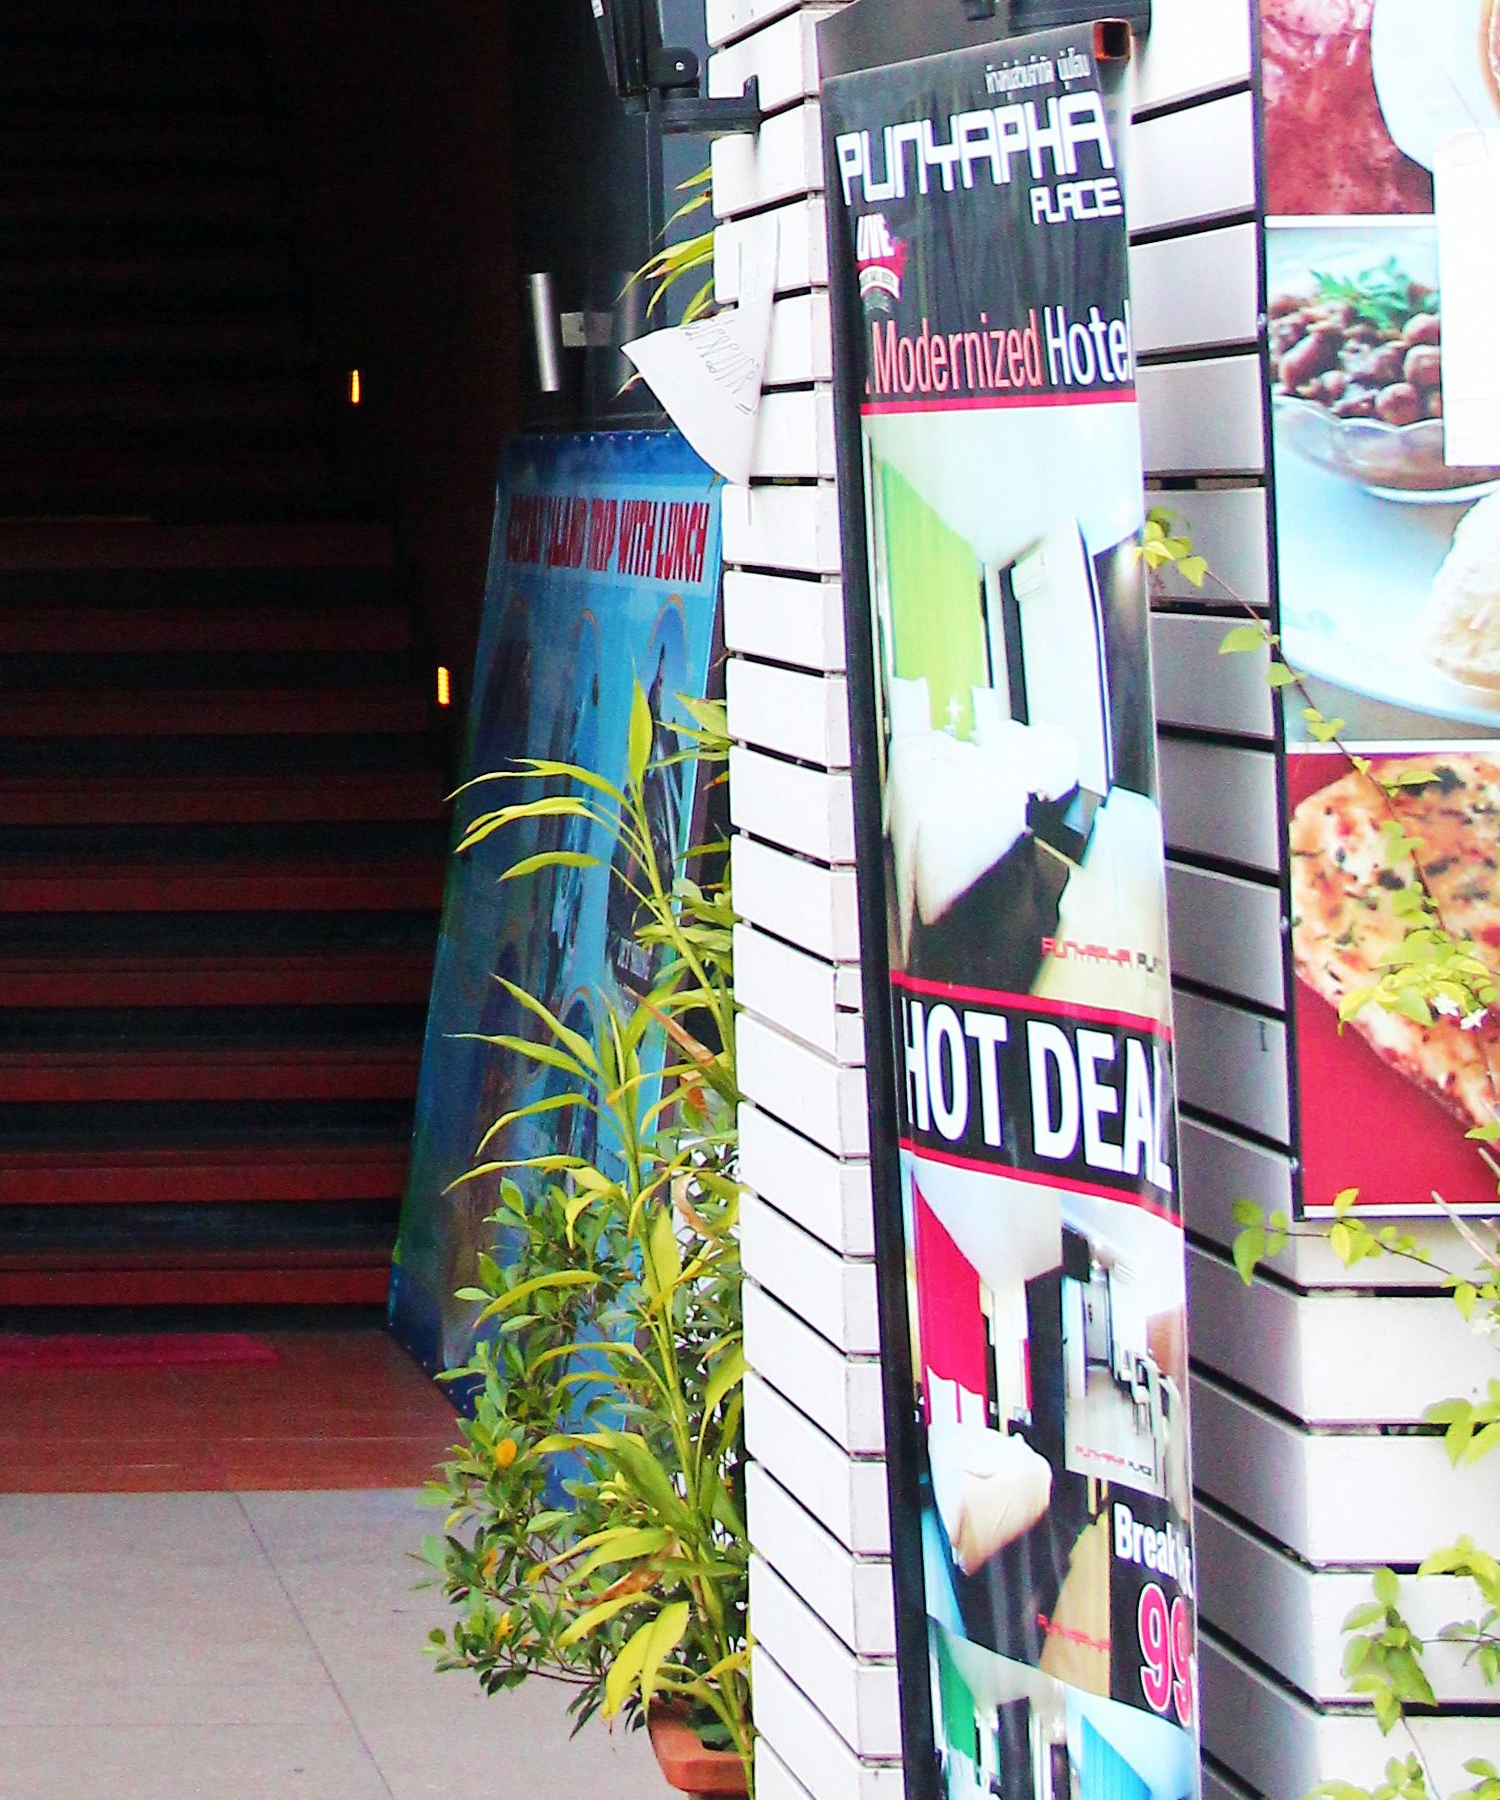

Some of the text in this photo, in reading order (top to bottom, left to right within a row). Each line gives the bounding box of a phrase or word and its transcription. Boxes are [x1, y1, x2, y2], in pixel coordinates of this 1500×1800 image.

[835, 89, 1115, 207] PUNYAPHA
[1029, 176, 1124, 226] PLACE
[871, 307, 1043, 394] Modernized
[654, 501, 711, 584] LUNCH
[901, 996, 1173, 1194] HOT DEAL
